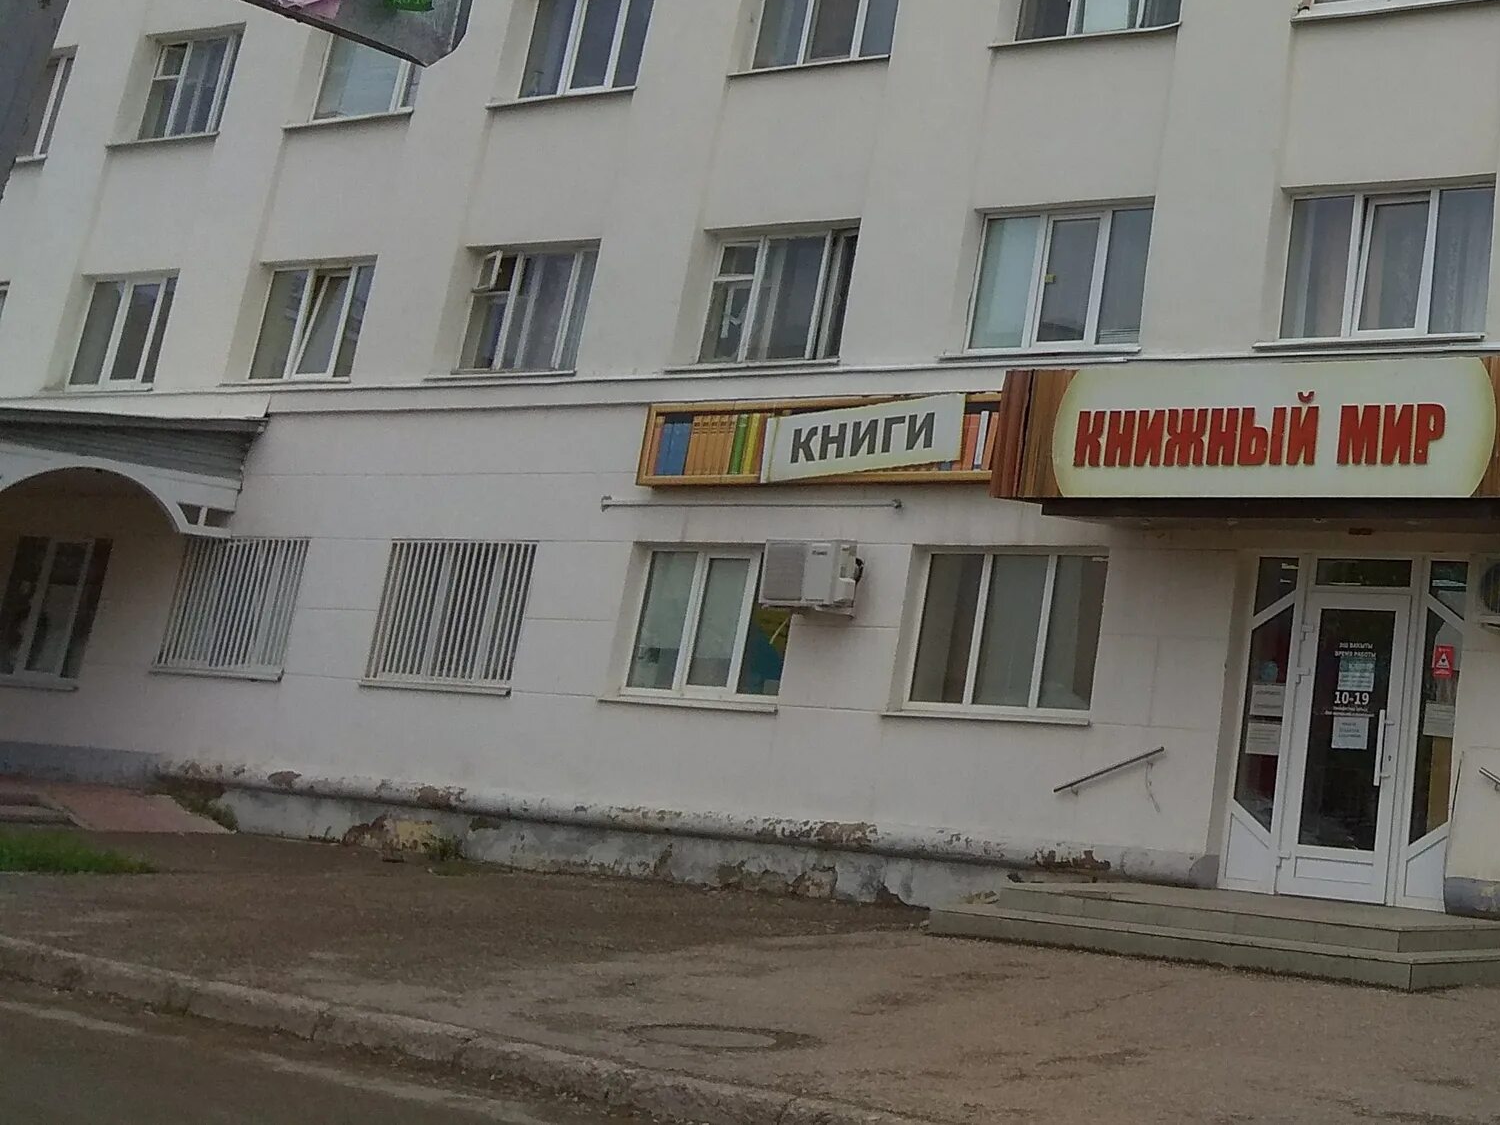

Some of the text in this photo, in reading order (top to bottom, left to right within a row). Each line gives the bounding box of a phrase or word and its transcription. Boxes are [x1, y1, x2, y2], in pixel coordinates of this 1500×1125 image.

[1072, 390, 1446, 467] КНИЖНЫЙ МИР
[1334, 691, 1370, 705] 10-19
